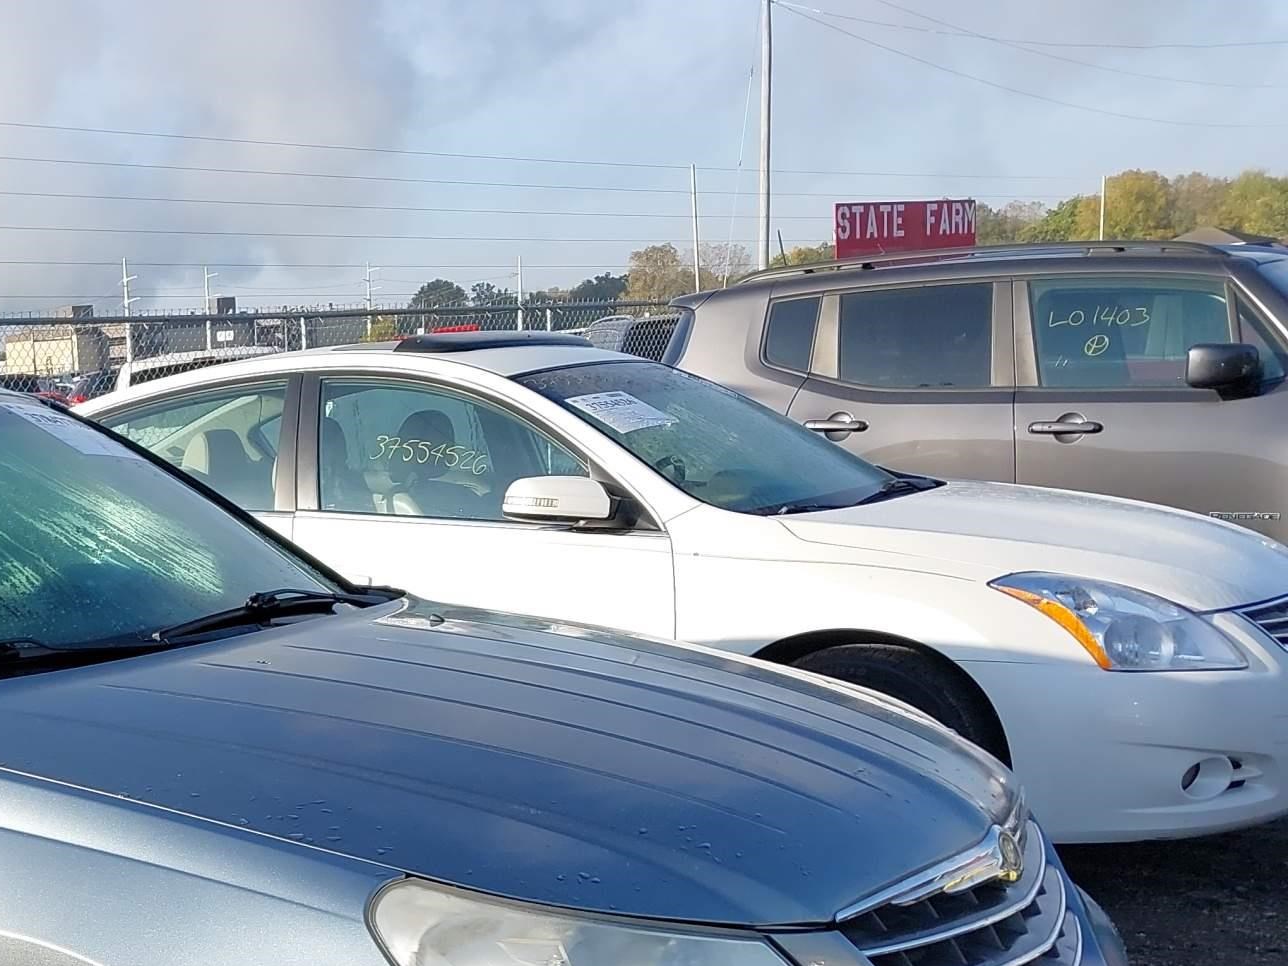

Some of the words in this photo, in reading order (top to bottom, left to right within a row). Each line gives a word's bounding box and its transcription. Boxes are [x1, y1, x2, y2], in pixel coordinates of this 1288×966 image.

[837, 204, 905, 240] STATE
[926, 202, 976, 236] FARM
[369, 435, 488, 475] 37554526
